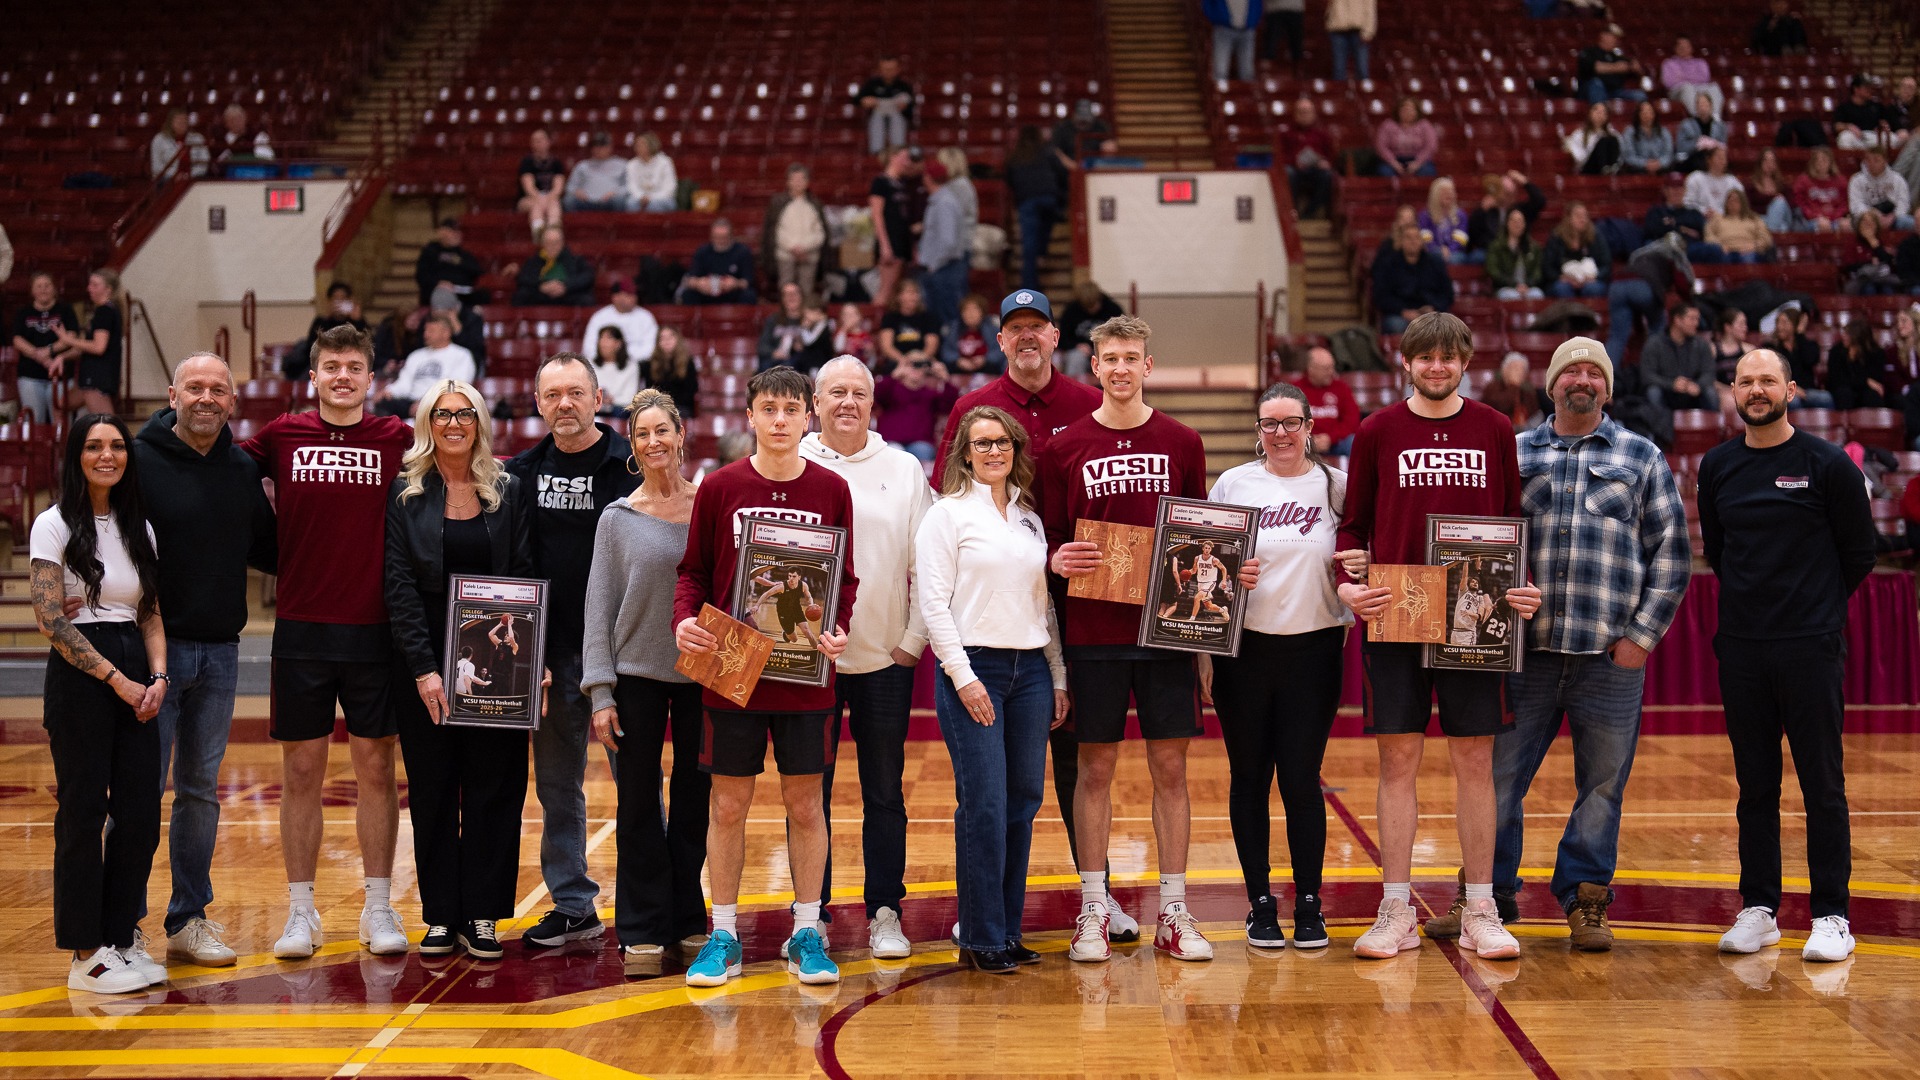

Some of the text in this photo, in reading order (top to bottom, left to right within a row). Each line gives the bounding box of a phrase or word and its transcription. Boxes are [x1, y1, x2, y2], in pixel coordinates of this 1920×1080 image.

[297, 450, 379, 469] VCSU
[1402, 452, 1483, 471] VCSU
[292, 469, 381, 486] RELENTLESS
[1085, 457, 1166, 481] VCSU
[1399, 473, 1486, 488] RELENTLESS
[1085, 479, 1170, 500] RELENTLESS
[1373, 571, 1387, 585] V
[1128, 587, 1142, 598] 21
[1466, 602, 1472, 610] 5
[1195, 624, 1222, 633] Basketball
[1428, 621, 1442, 640] 5
[1485, 617, 1507, 639] 23
[783, 652, 810, 660] Basketball
[731, 683, 747, 700] 2
